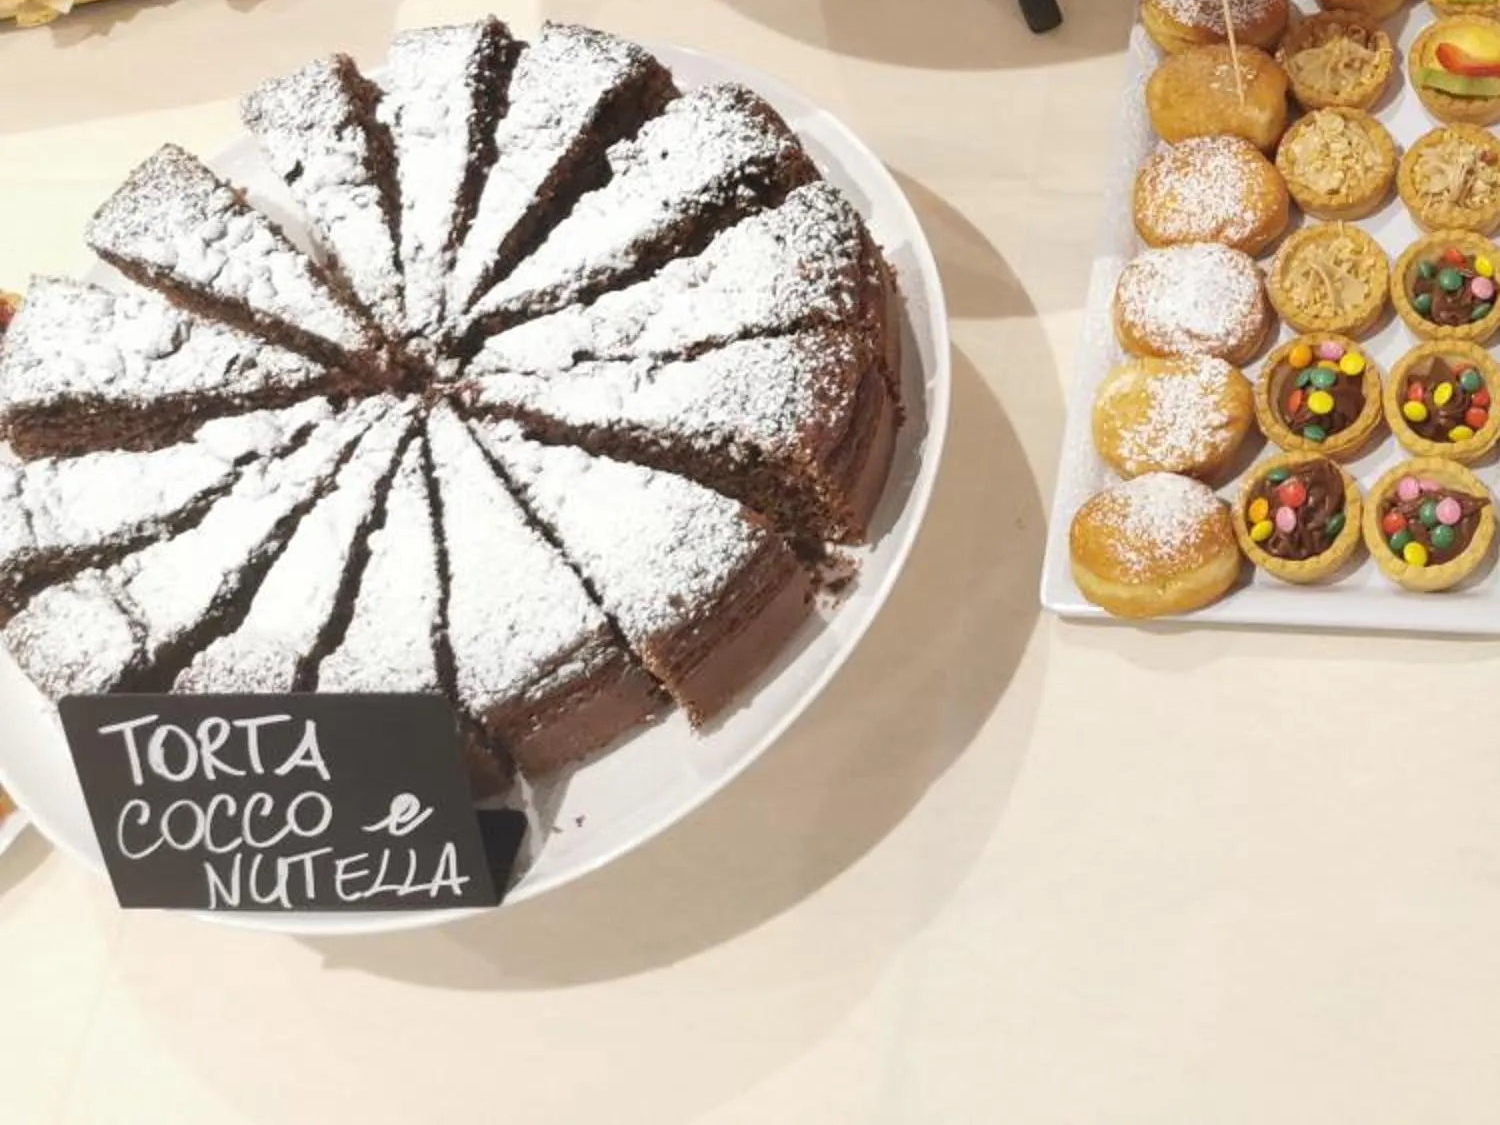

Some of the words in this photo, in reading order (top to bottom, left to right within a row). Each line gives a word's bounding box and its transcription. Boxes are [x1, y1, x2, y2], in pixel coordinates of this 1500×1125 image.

[98, 713, 332, 786] TORTA
[117, 791, 333, 860] COCCO
[204, 841, 471, 910] NUTELLA
